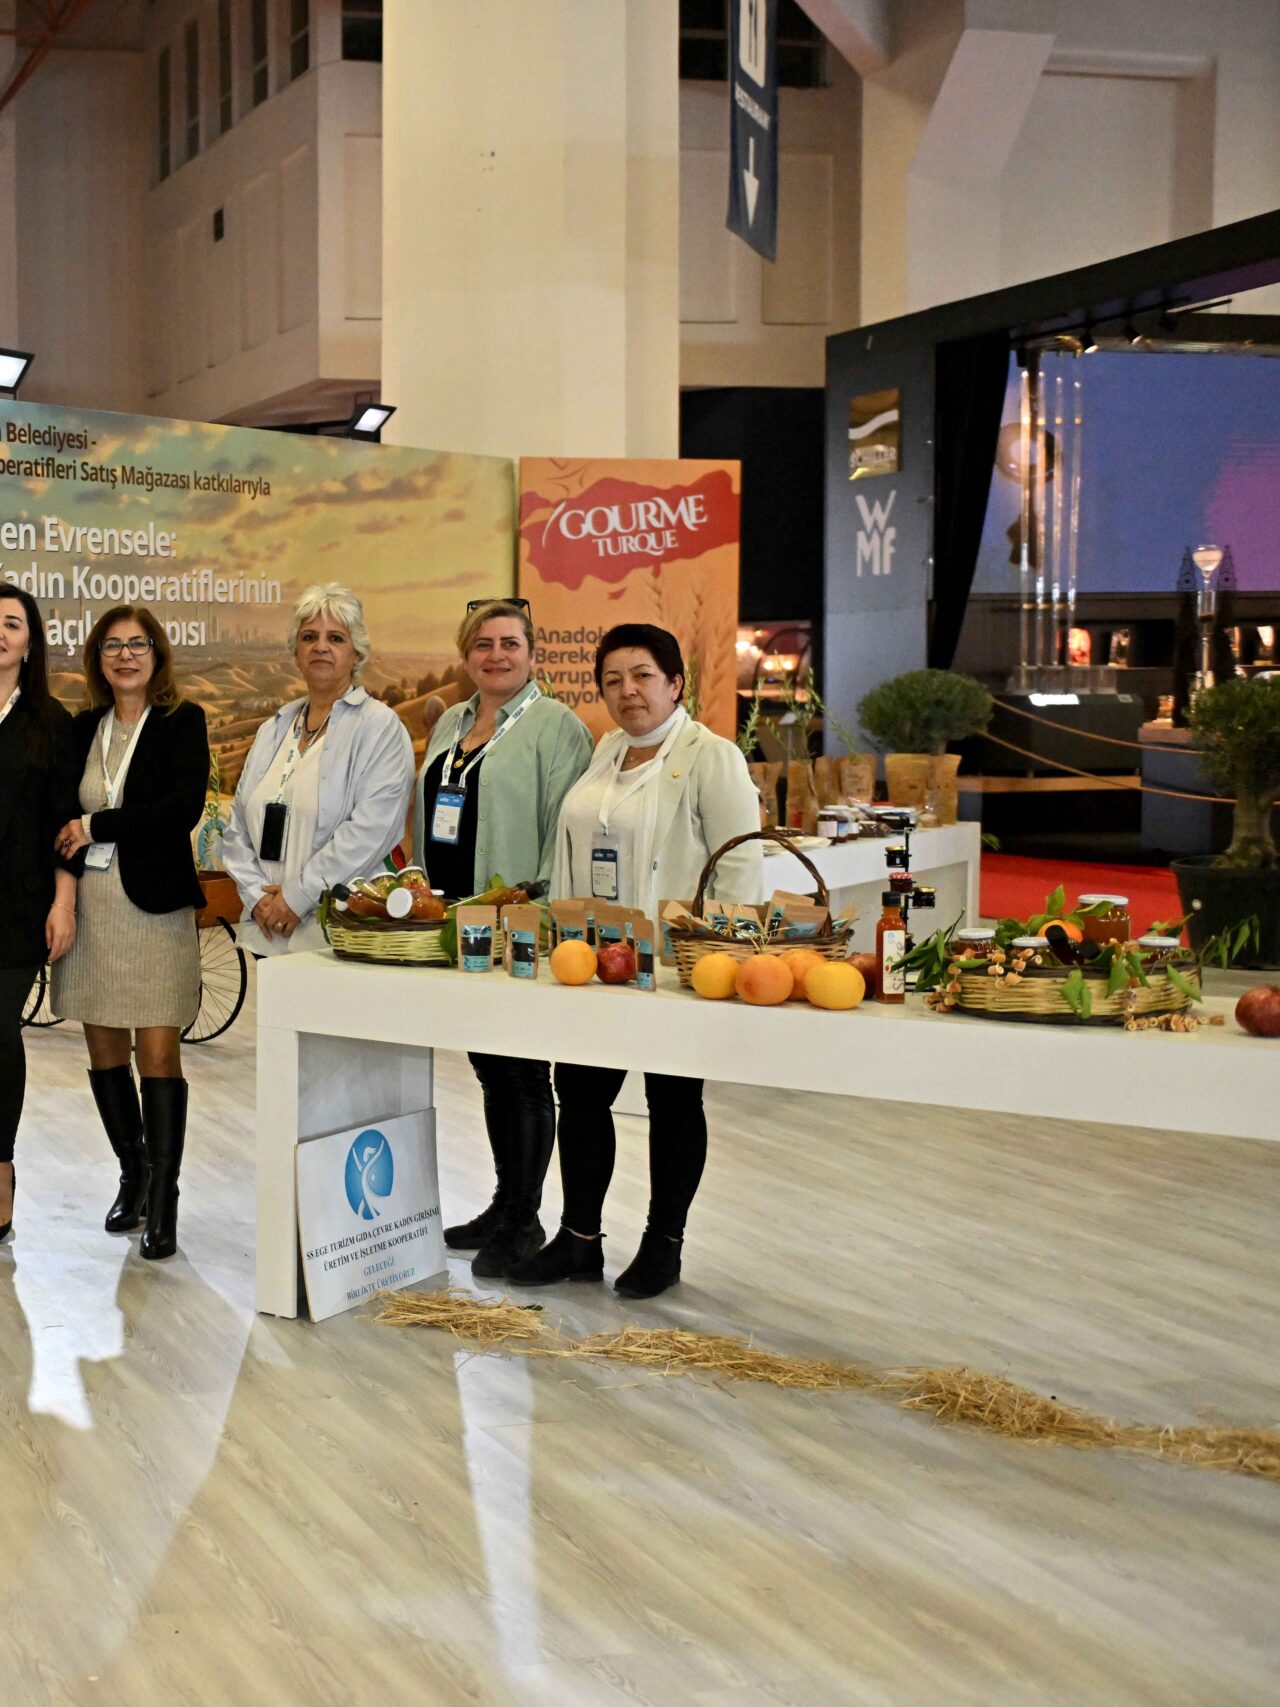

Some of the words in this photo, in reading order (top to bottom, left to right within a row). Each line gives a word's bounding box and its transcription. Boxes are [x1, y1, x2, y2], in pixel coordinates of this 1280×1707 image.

[6, 421, 88, 452] Belediyesi
[80, 461, 118, 488] Satış
[120, 466, 190, 492] Mağazası
[193, 470, 271, 497] katkılarıyla
[44, 517, 177, 557] Evrensele:
[558, 493, 709, 541] GOURME
[592, 528, 680, 558] TURQUE
[72, 565, 282, 605] Kooperatiflerinin
[315, 1245, 329, 1258] EGE
[330, 1235, 355, 1253] TURİZM
[355, 1231, 372, 1243] GIDA
[372, 1223, 393, 1240] ÇEVRE
[393, 1217, 413, 1230] KADIN
[323, 1255, 349, 1271] ÜRETİM
[350, 1251, 359, 1260] VE
[359, 1241, 388, 1259] İŞLETME
[388, 1224, 428, 1247] KOOPERATİFİ
[363, 1256, 395, 1276] GELECEĞİ
